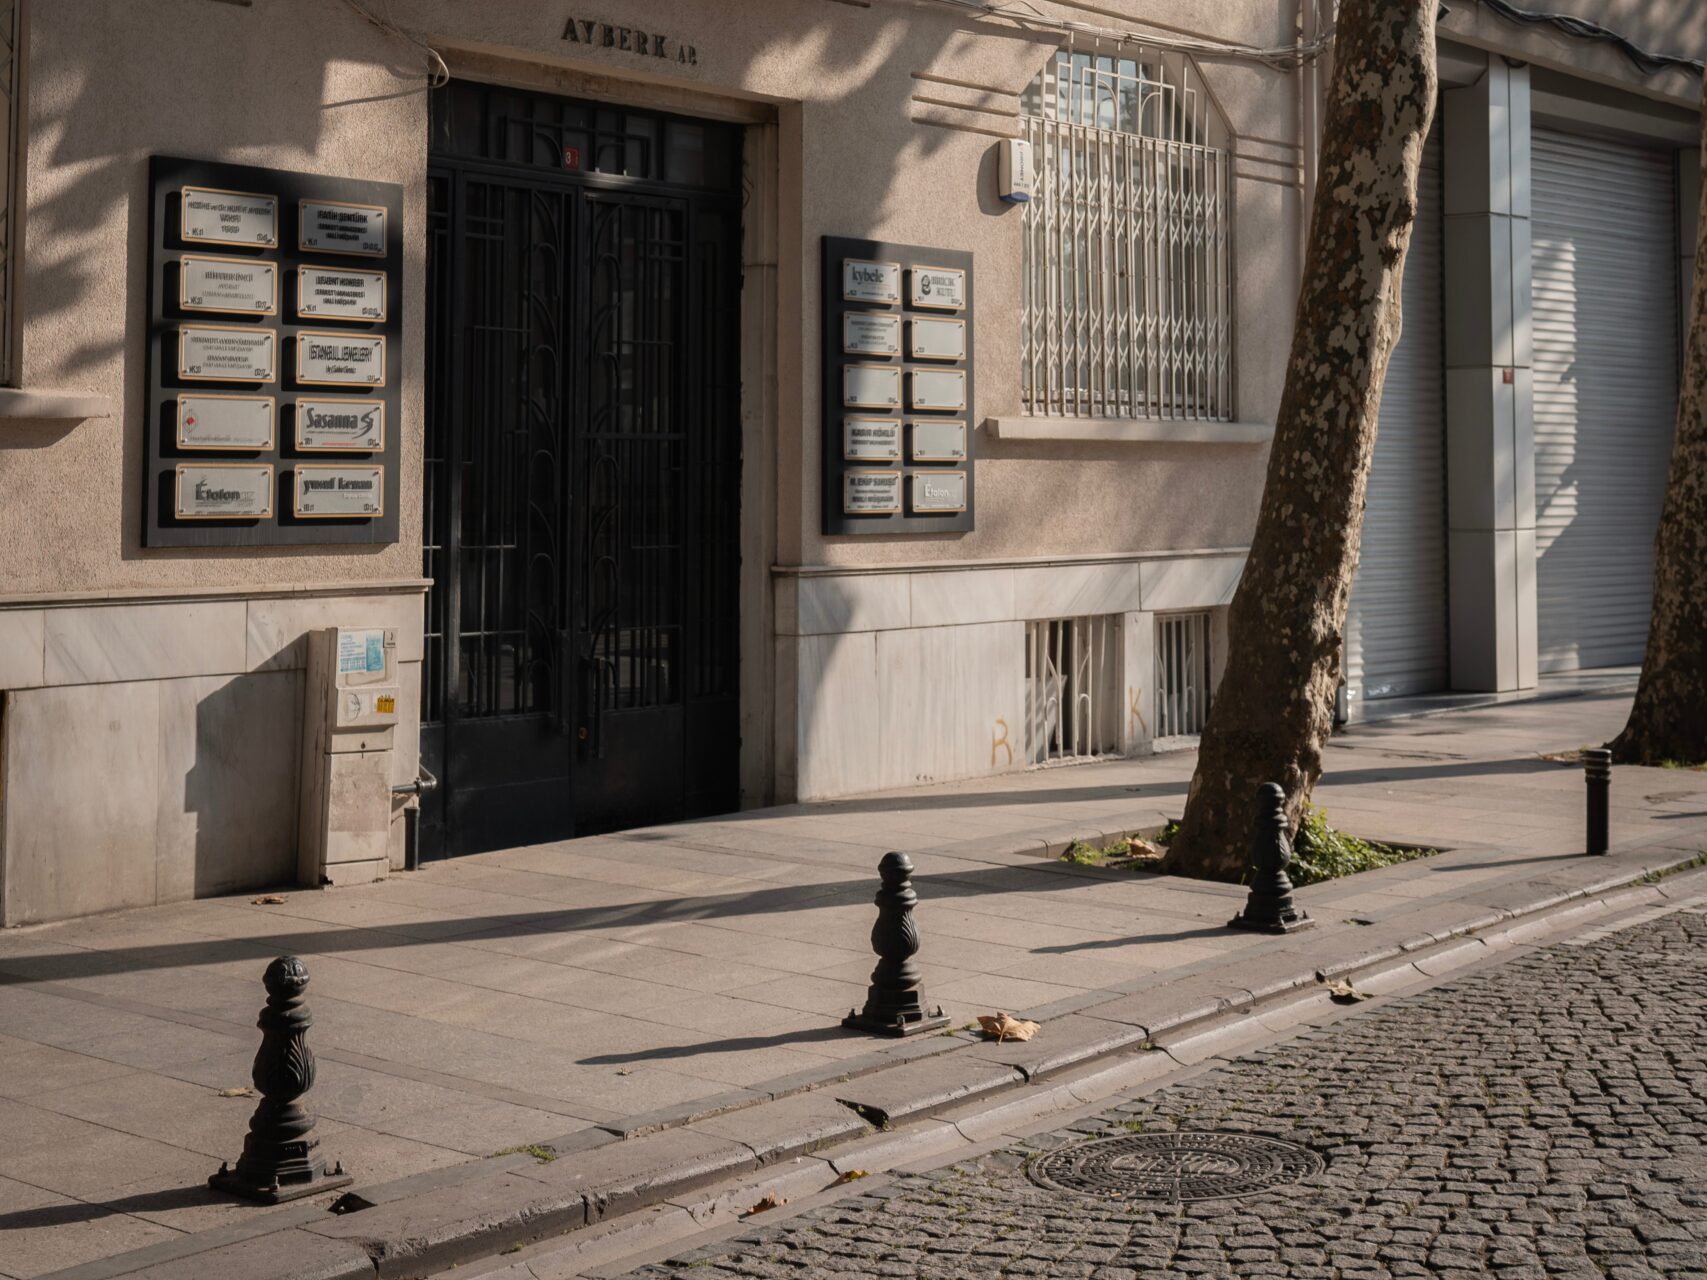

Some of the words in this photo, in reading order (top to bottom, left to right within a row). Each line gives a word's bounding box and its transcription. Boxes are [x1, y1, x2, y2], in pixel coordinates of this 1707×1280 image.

[561, 17, 668, 59] AYBERK
[852, 266, 884, 285] kybele
[306, 407, 359, 430] Sasanna
